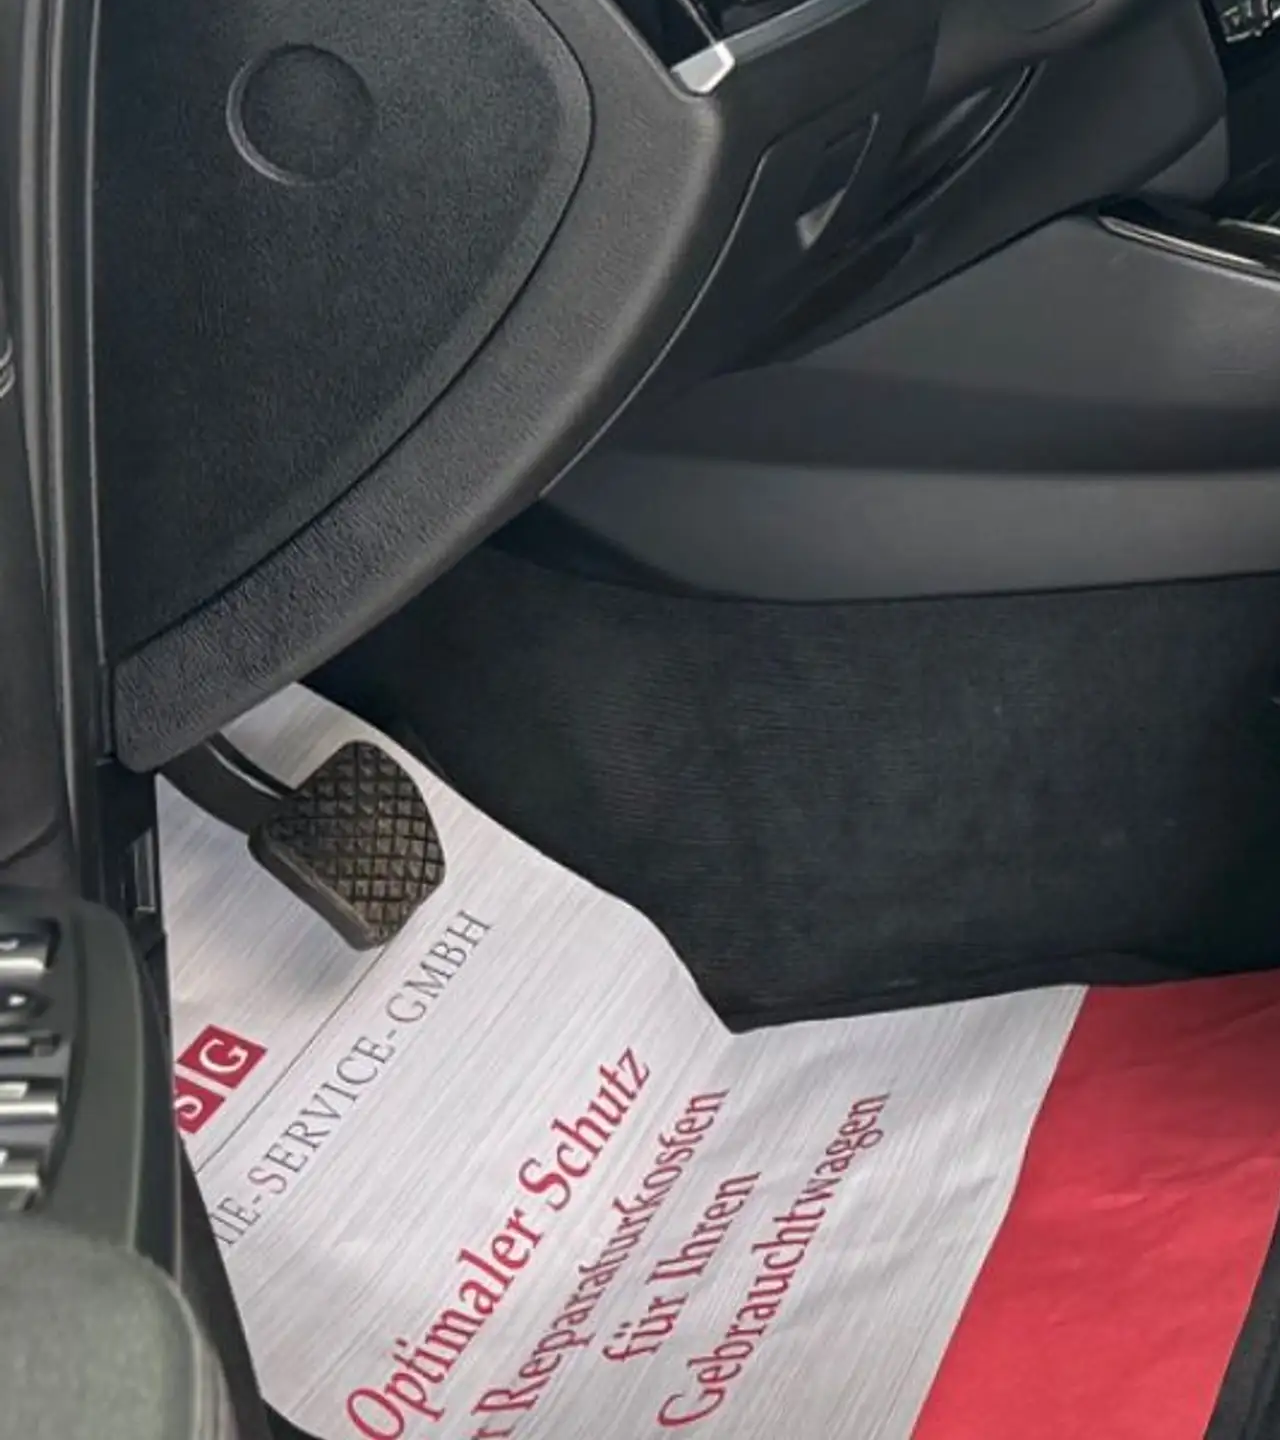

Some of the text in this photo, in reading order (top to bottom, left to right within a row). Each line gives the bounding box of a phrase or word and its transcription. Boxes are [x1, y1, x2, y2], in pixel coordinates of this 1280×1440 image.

[345, 1046, 652, 1440] Optimaler Schutz
[470, 1088, 731, 1416] Reparaturkosten
[602, 1171, 763, 1362] für Ihren
[656, 1091, 891, 1429] Gebrauchtwagen
